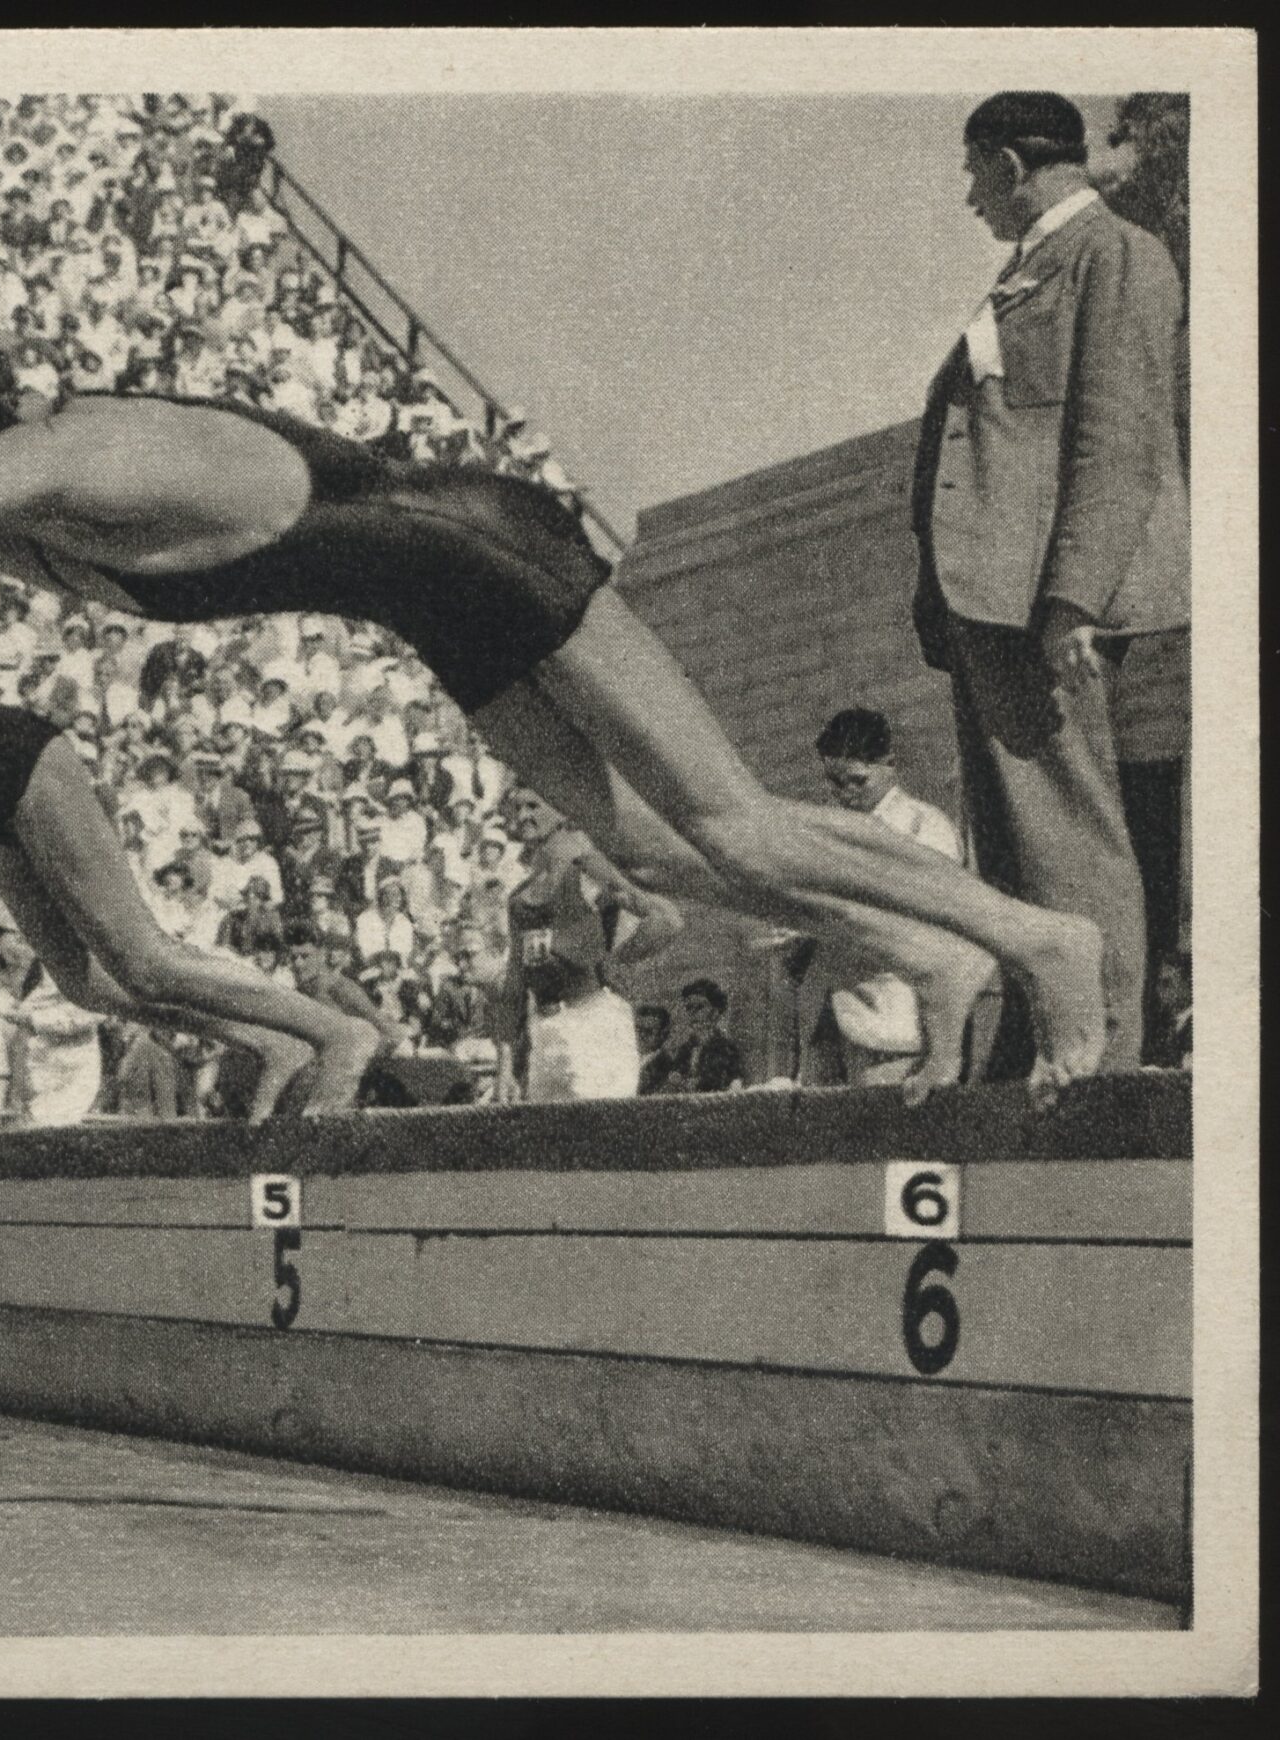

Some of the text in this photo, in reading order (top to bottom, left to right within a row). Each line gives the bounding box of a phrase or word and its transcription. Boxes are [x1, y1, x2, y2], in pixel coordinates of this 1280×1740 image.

[263, 1183, 291, 1219] 5
[901, 1171, 948, 1226] 6
[272, 1228, 300, 1329] 5
[903, 1239, 960, 1375] 6
